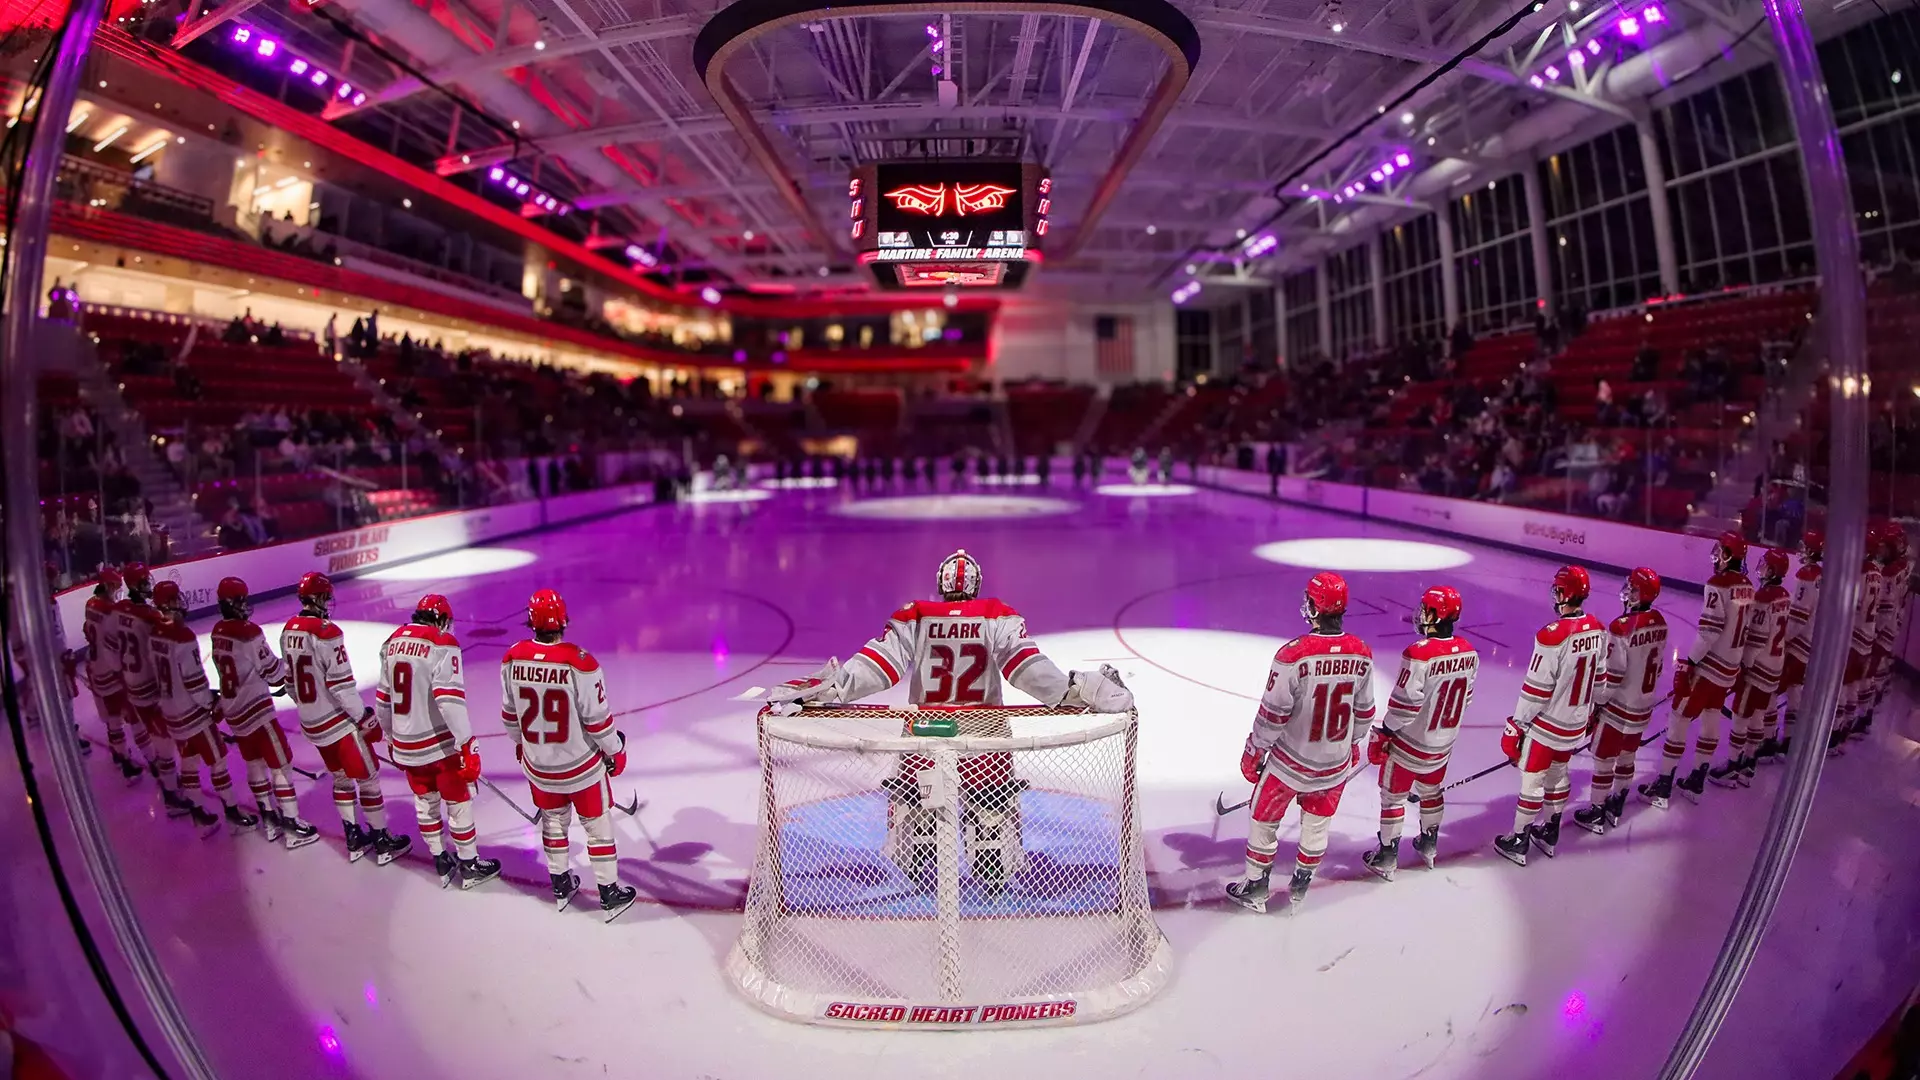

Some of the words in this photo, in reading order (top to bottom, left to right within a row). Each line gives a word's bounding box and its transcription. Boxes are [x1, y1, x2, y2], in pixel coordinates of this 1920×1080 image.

[877, 249, 932, 260] MARTIRE
[935, 248, 981, 259] FAMILY
[982, 248, 1024, 259] ARENA
[314, 536, 356, 556] SACRED
[358, 528, 390, 547] HEART
[328, 547, 380, 572] PIONEERS
[1706, 591, 1719, 609] 12
[1752, 608, 1766, 626] 20
[928, 622, 982, 639] CLARK
[1572, 635, 1600, 654] SPOTT
[451, 655, 459, 675] 9
[512, 664, 570, 685] HLUSIAK
[924, 643, 990, 703] 32
[1314, 659, 1370, 678] ROBBINS
[1428, 655, 1476, 678] HANZAWA
[1530, 653, 1543, 673] 11
[393, 660, 413, 716] 9
[1397, 667, 1411, 690] 10
[1569, 653, 1597, 707] 11
[594, 679, 607, 704] 2
[518, 686, 570, 745] 29
[1308, 680, 1354, 743] 16
[1428, 676, 1468, 732] 10
[825, 1002, 907, 1023] SACRED
[908, 1005, 978, 1023] HEART
[978, 1000, 1078, 1023] PIONEERS
